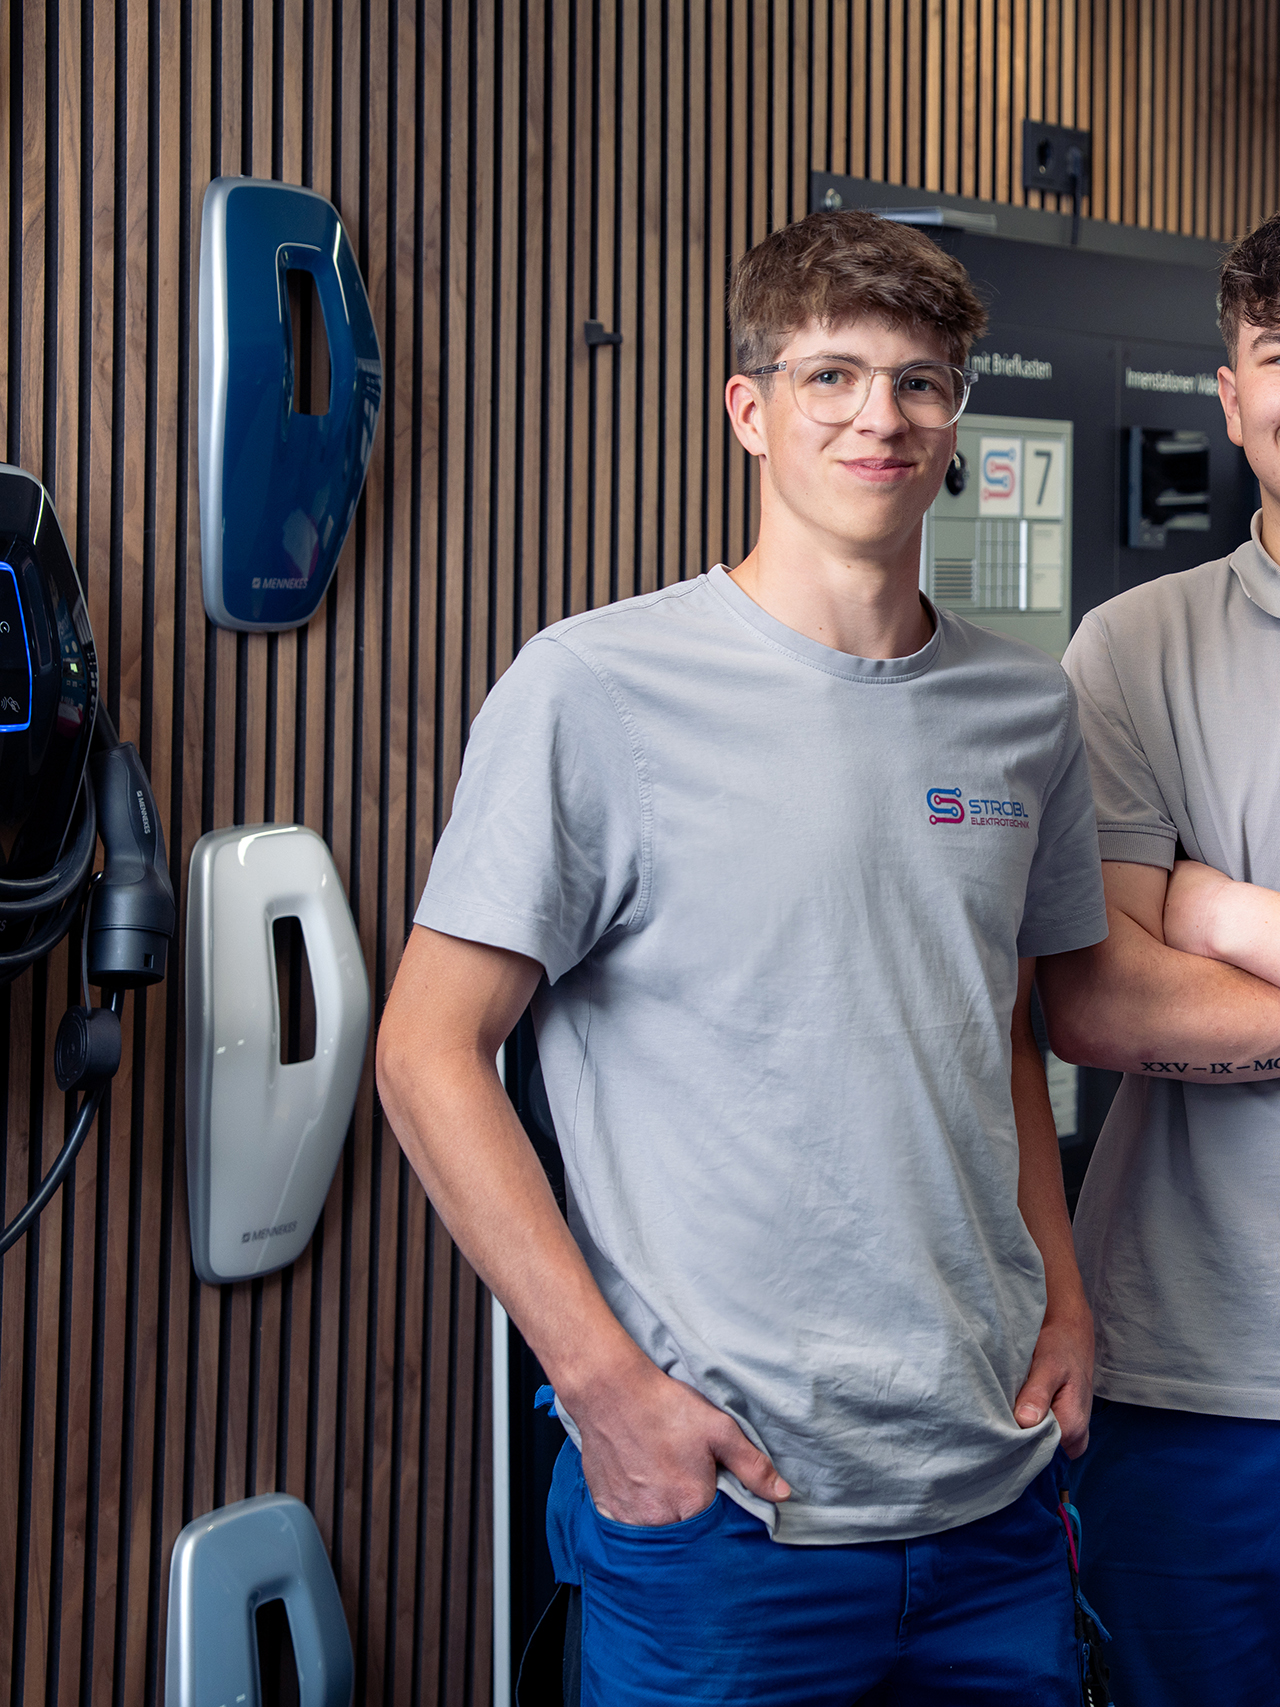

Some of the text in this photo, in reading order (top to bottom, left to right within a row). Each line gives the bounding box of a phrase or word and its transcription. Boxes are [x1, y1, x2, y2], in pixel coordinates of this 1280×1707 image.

[992, 352, 1053, 380] Briefkasten
[1034, 451, 1052, 506] 7
[262, 577, 308, 589] MENNEKES
[968, 799, 1029, 818] STROBL
